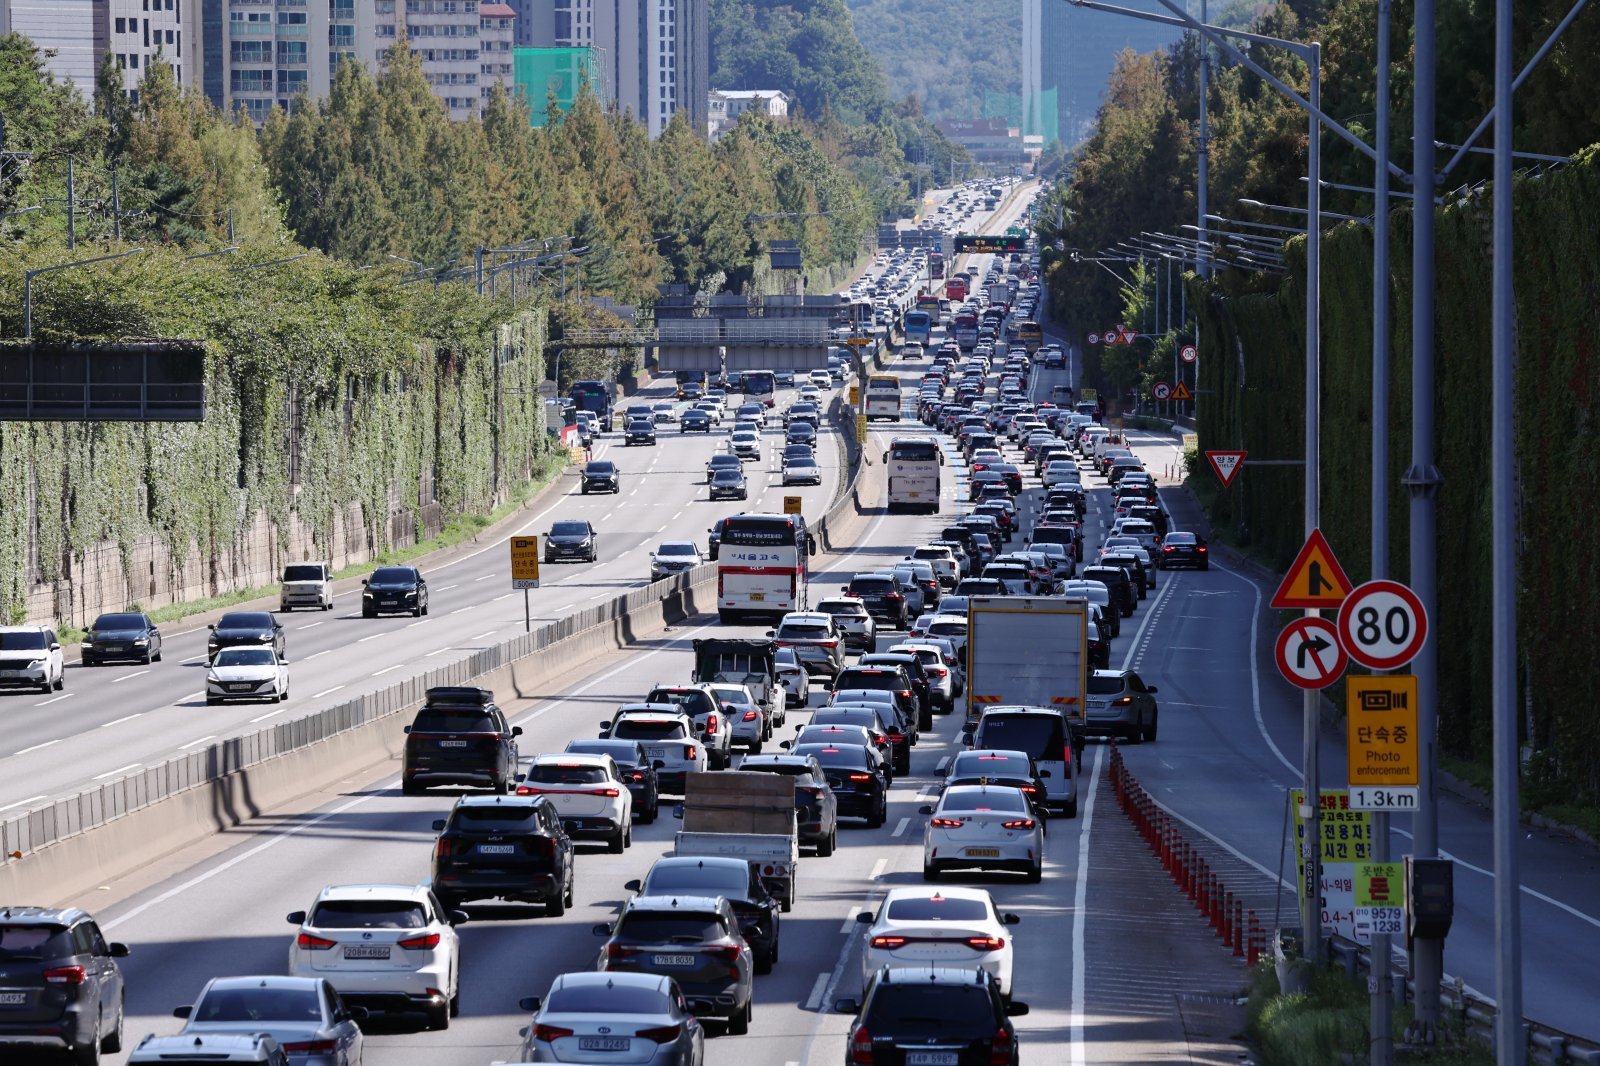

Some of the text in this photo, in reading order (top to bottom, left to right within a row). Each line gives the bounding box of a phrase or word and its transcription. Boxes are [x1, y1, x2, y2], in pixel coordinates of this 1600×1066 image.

[1184, 350, 1194, 358] 80
[1356, 606, 1411, 646] 80
[1357, 726, 1409, 745] 단속중
[1366, 751, 1401, 763] Photo
[1357, 765, 1411, 776] enforcement
[1357, 790, 1414, 807] 1.3km
[1369, 876, 1390, 900] 돈
[1356, 907, 1401, 920] 010 9579
[1372, 920, 1401, 933] 1238
